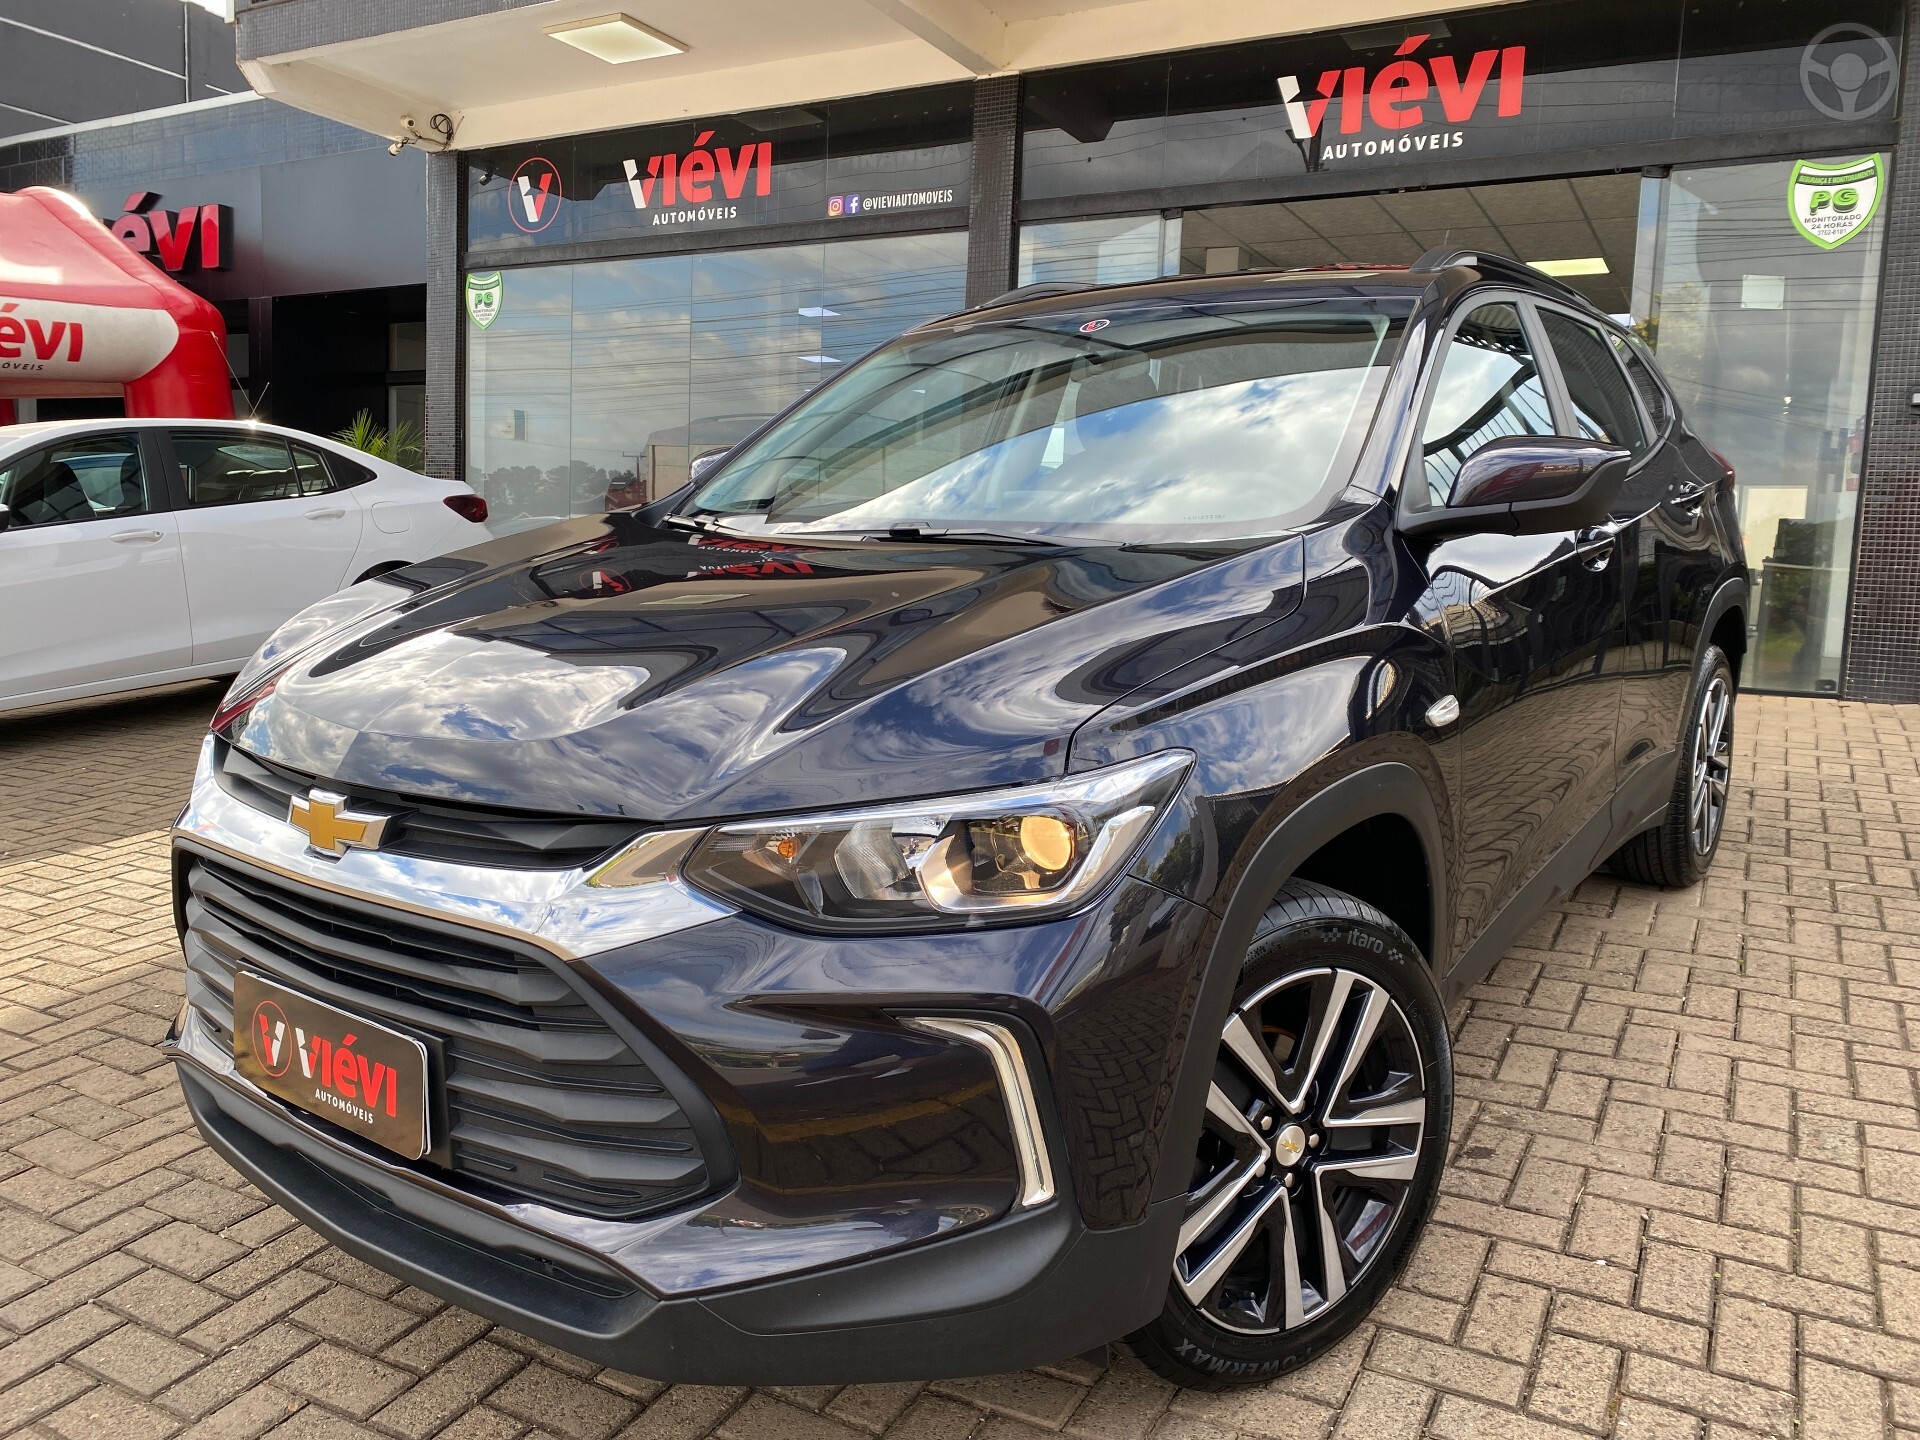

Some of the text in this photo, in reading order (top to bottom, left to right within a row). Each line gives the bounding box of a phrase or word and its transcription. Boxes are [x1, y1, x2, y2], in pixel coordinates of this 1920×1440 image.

[1322, 131, 1464, 161] AUTOMÓVEIS
[862, 189, 953, 210] @VIEVIAUTOMOVEIS
[1809, 188, 1859, 214] PG
[652, 206, 738, 226] AUTOMÓVEIS
[1804, 214, 1861, 223] MONITORADO
[1823, 221, 1854, 229] HORAS
[0, 361, 44, 371] ÓVEIS
[315, 1088, 374, 1124] AUTOMÓVEIS
